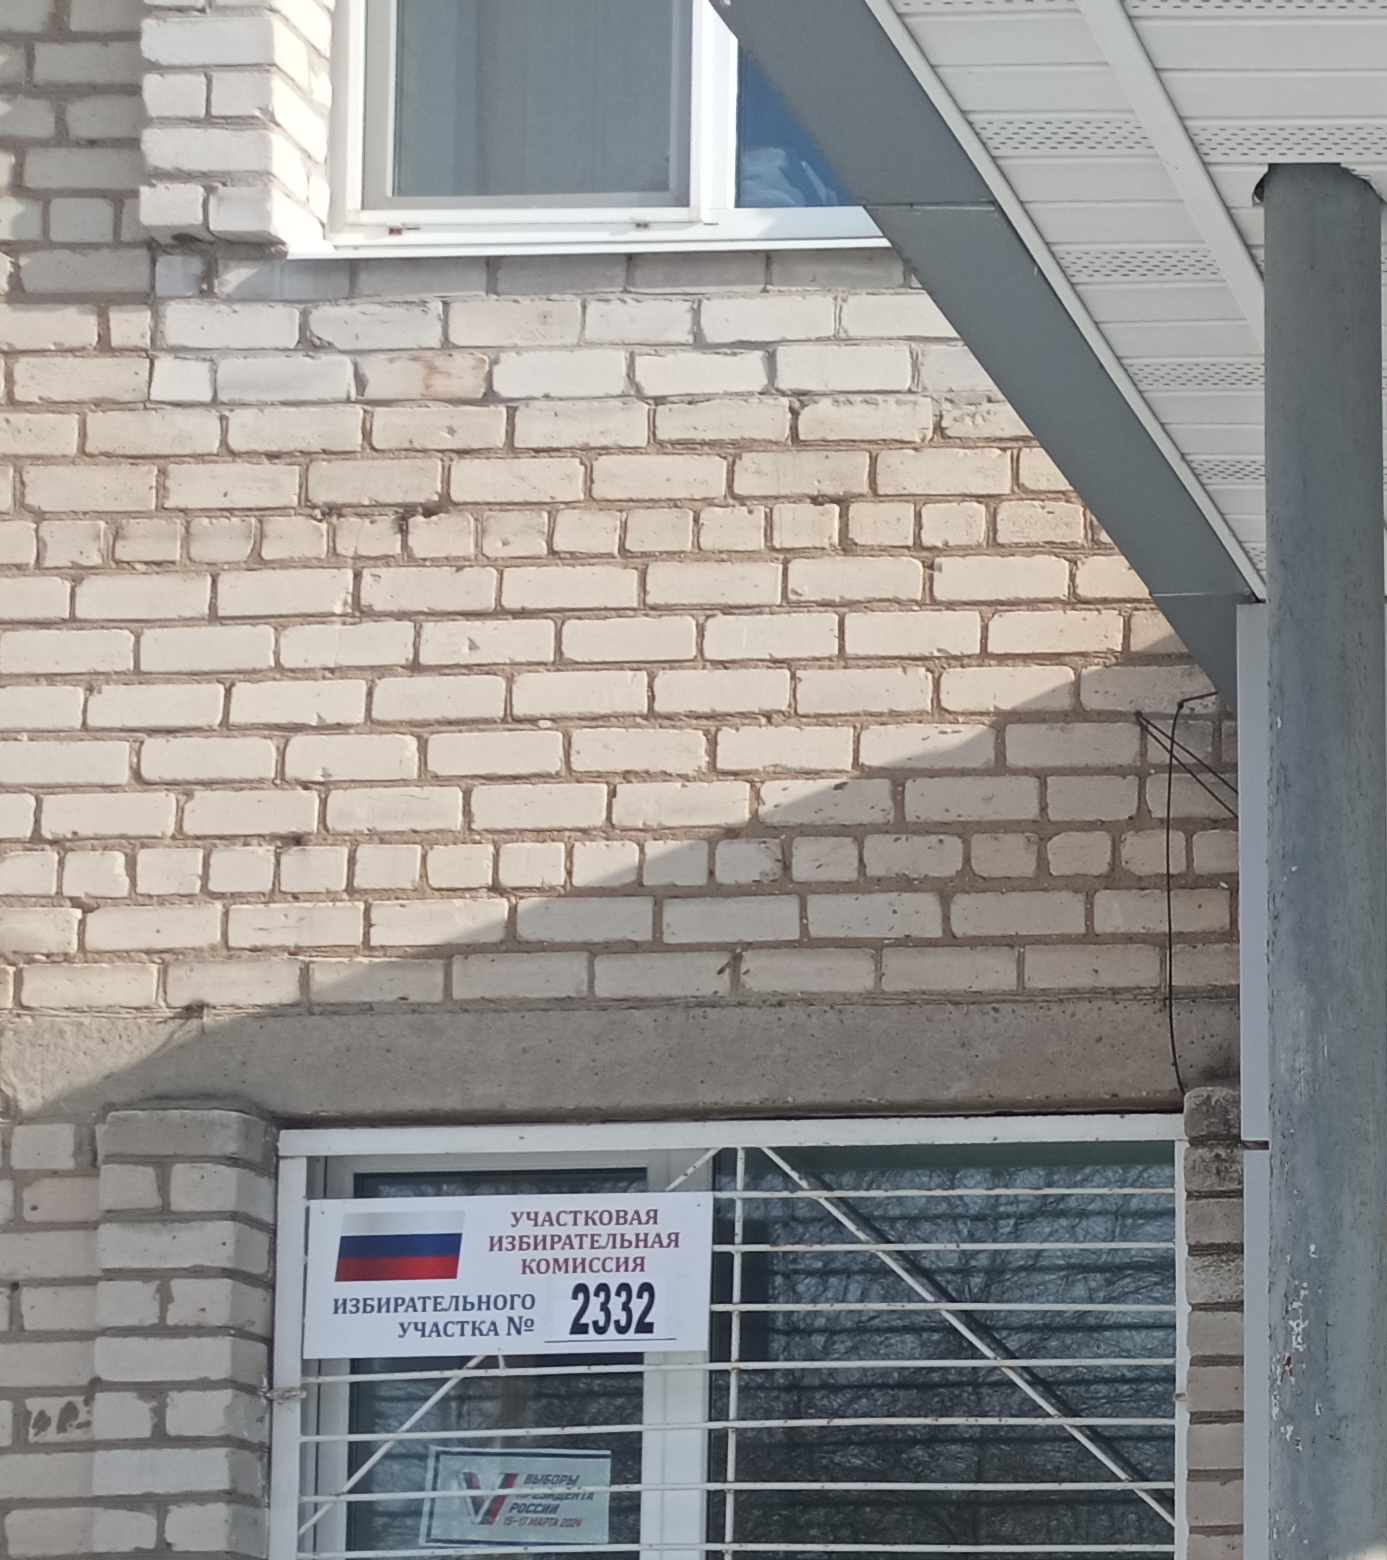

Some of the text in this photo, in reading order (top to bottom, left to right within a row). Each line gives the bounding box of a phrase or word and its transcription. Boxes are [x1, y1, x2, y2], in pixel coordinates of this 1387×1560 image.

[510, 1209, 659, 1228] УЧАСТКОВАЯ
[488, 1232, 680, 1252] ИЗБИРАТЕЛЬНАЯ
[521, 1256, 646, 1275] КОМИССИЯ
[332, 1293, 536, 1315] ИЗБИРАТЕЛЬНОГО
[398, 1282, 656, 1340] УЧАСТКА № 2332
[524, 1473, 580, 1486] ВЫБОРЫ
[508, 1502, 560, 1515] РОССИИ
[527, 1517, 558, 1527] МАРТА
[559, 1518, 582, 1528] 2024
